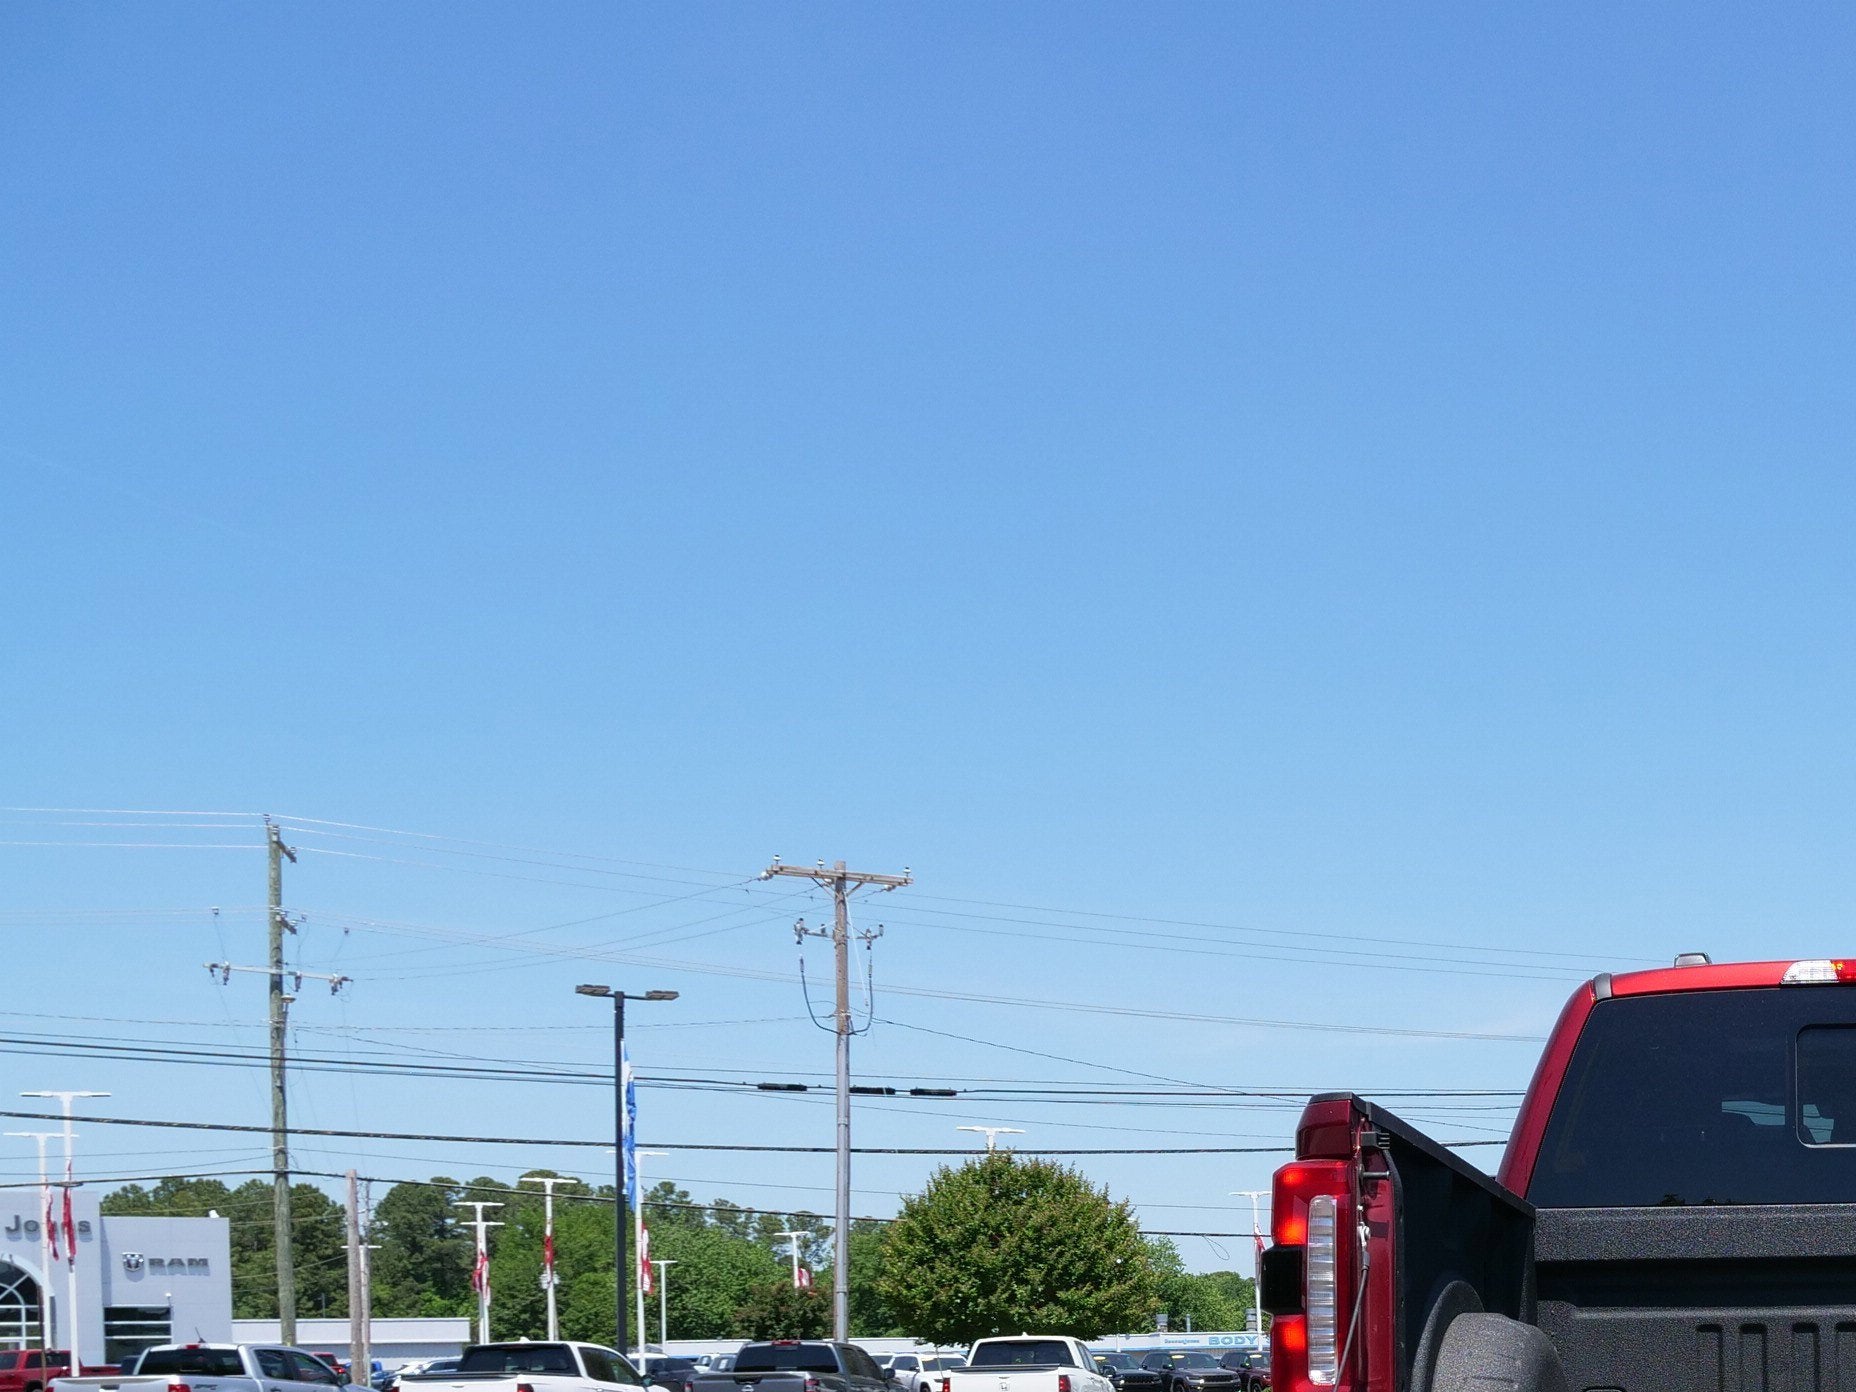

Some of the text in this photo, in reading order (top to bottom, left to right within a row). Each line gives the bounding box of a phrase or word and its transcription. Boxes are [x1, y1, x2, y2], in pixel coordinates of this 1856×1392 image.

[4, 1214, 92, 1234] Jos
[149, 1257, 209, 1267] RAM
[1208, 1336, 1258, 1345] BODY
